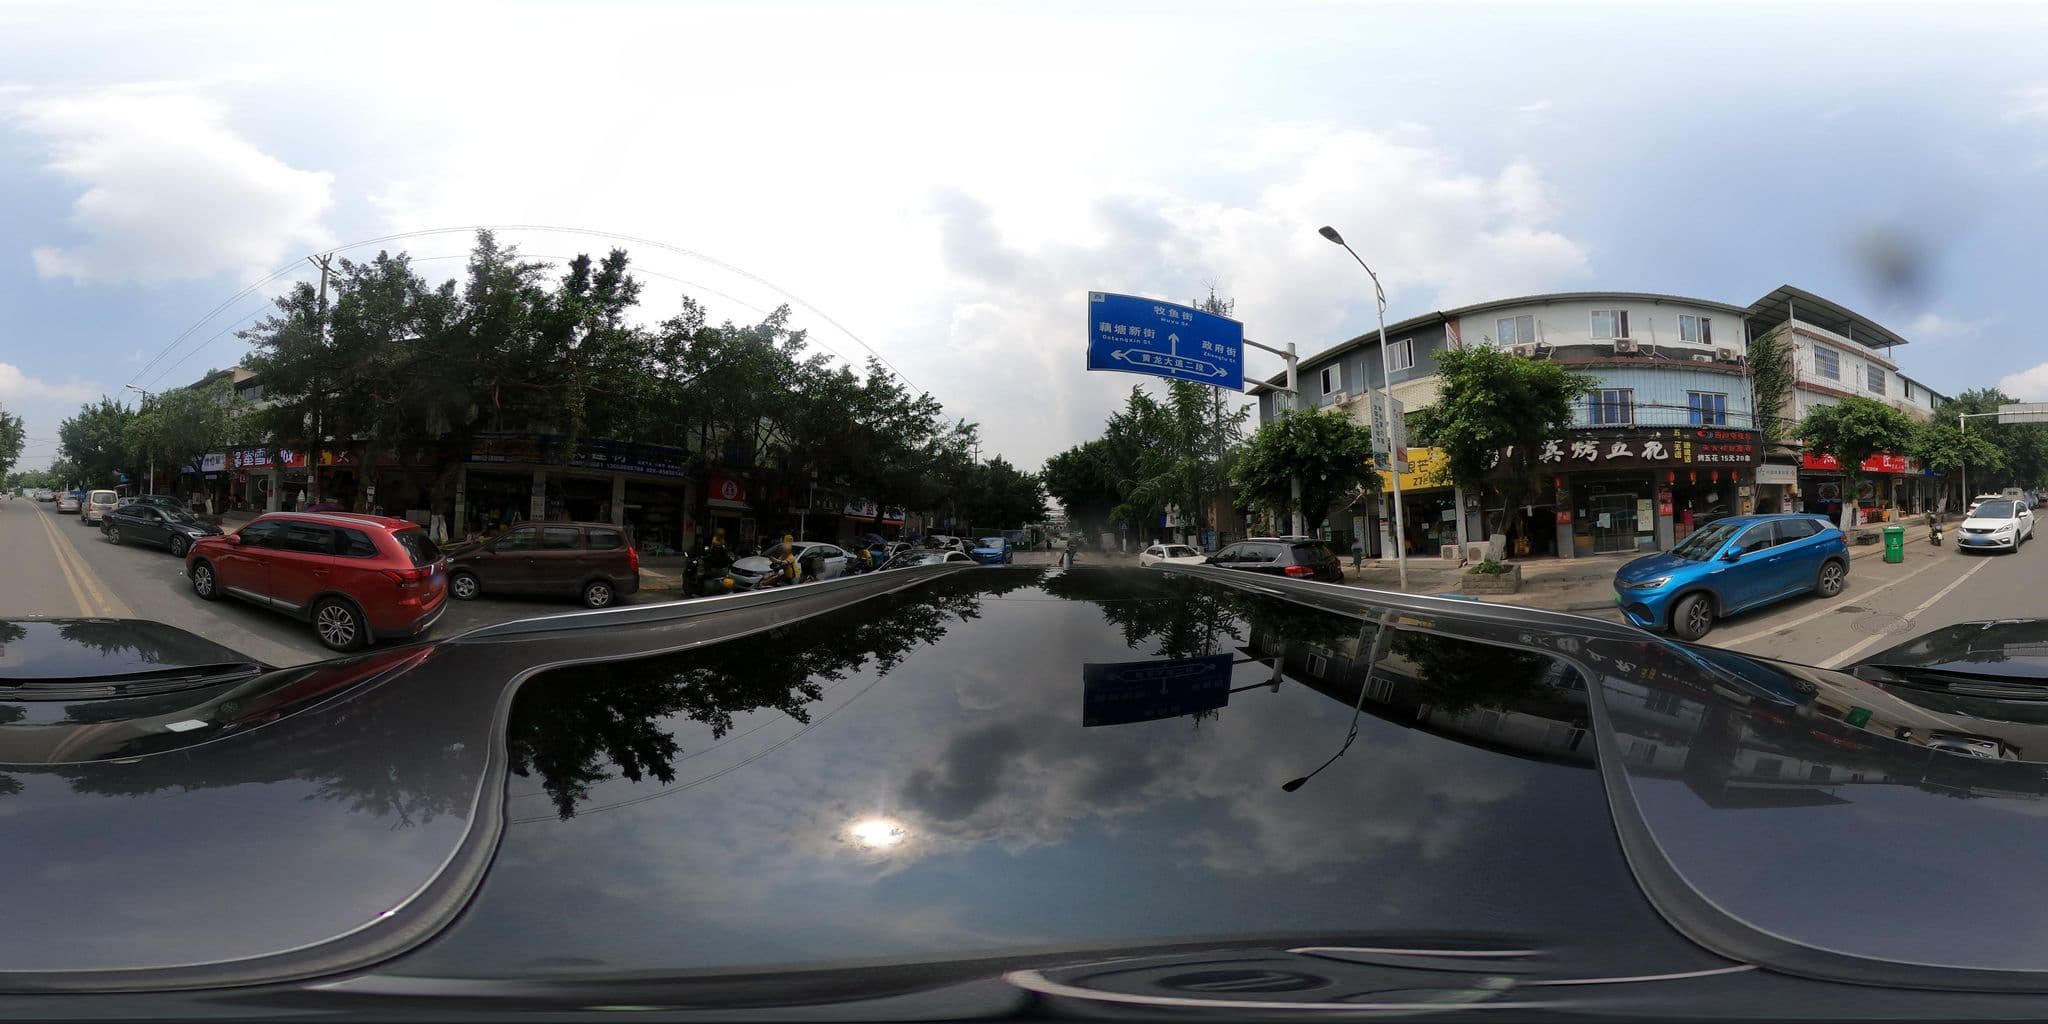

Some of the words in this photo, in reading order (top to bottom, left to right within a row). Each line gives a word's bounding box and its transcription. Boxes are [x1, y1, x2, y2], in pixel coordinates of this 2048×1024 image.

[1099, 321, 1155, 339] 藕塘新街
[1202, 340, 1236, 357] 政府街
[1142, 353, 1204, 372] 黄龙大道二段
